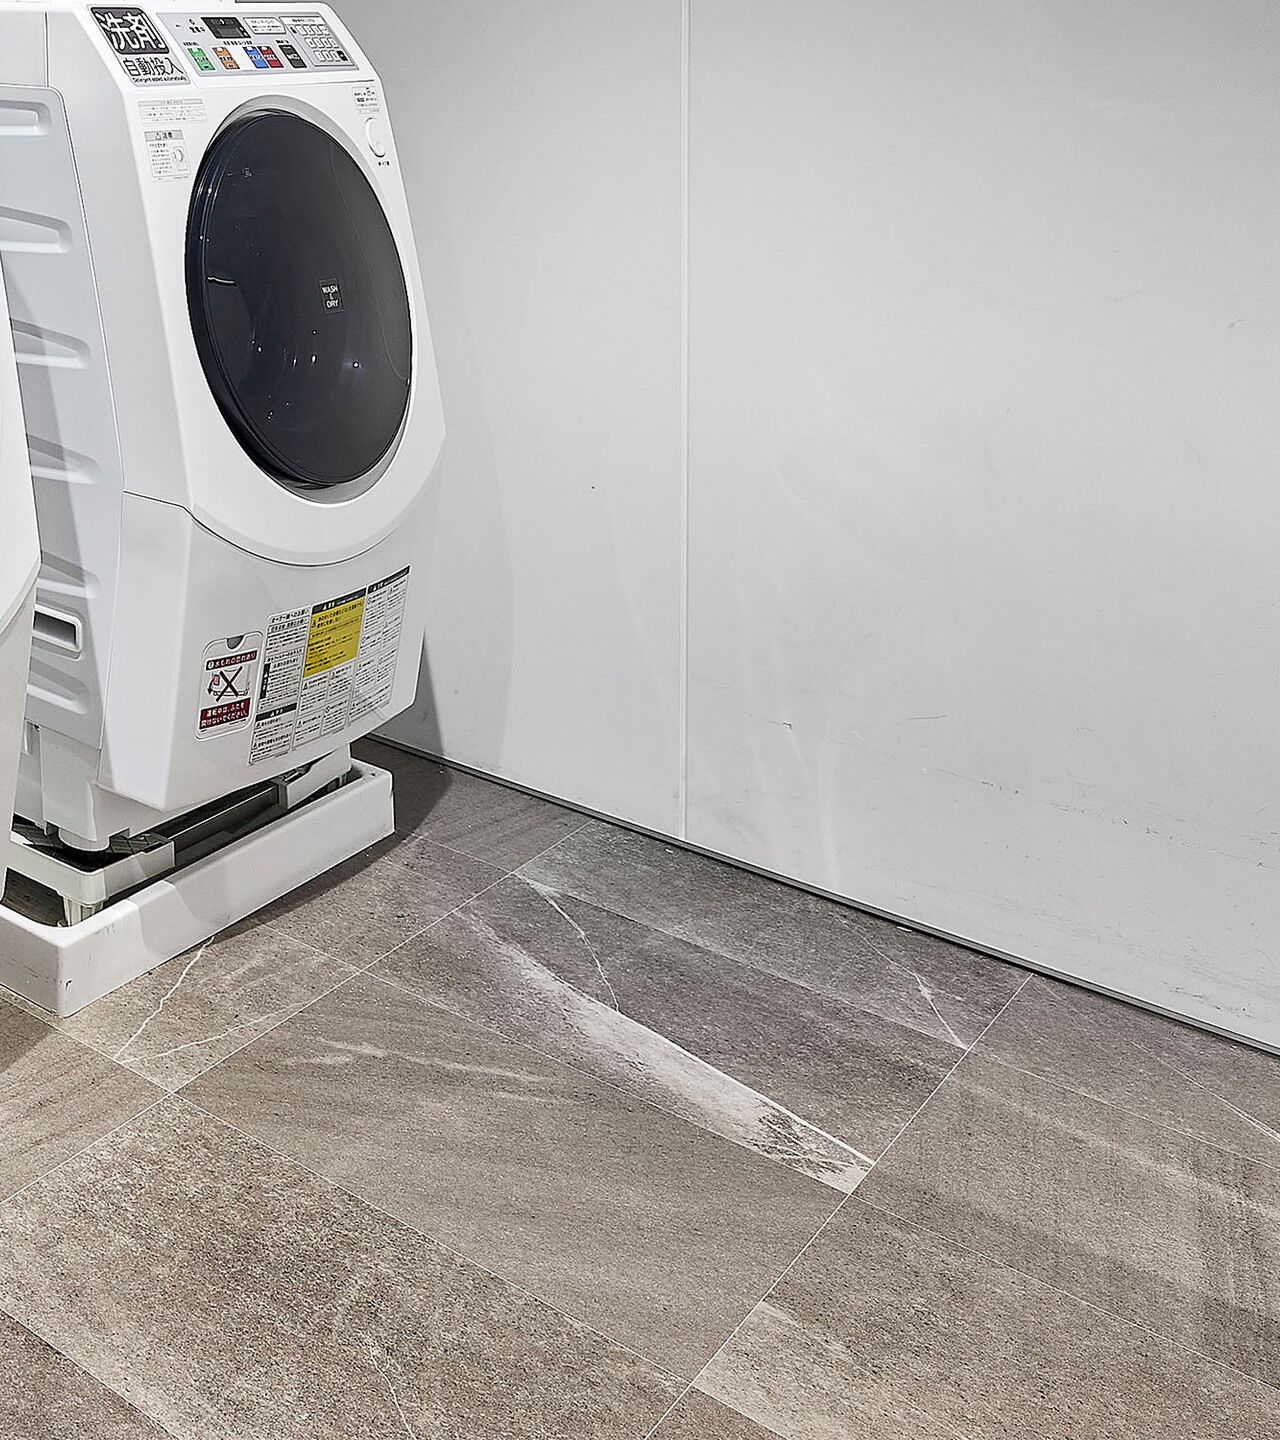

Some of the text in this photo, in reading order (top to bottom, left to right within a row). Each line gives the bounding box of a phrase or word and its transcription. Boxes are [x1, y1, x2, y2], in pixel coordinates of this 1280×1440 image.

[94, 12, 166, 50] 洗剤
[123, 57, 184, 76] 自動投入
